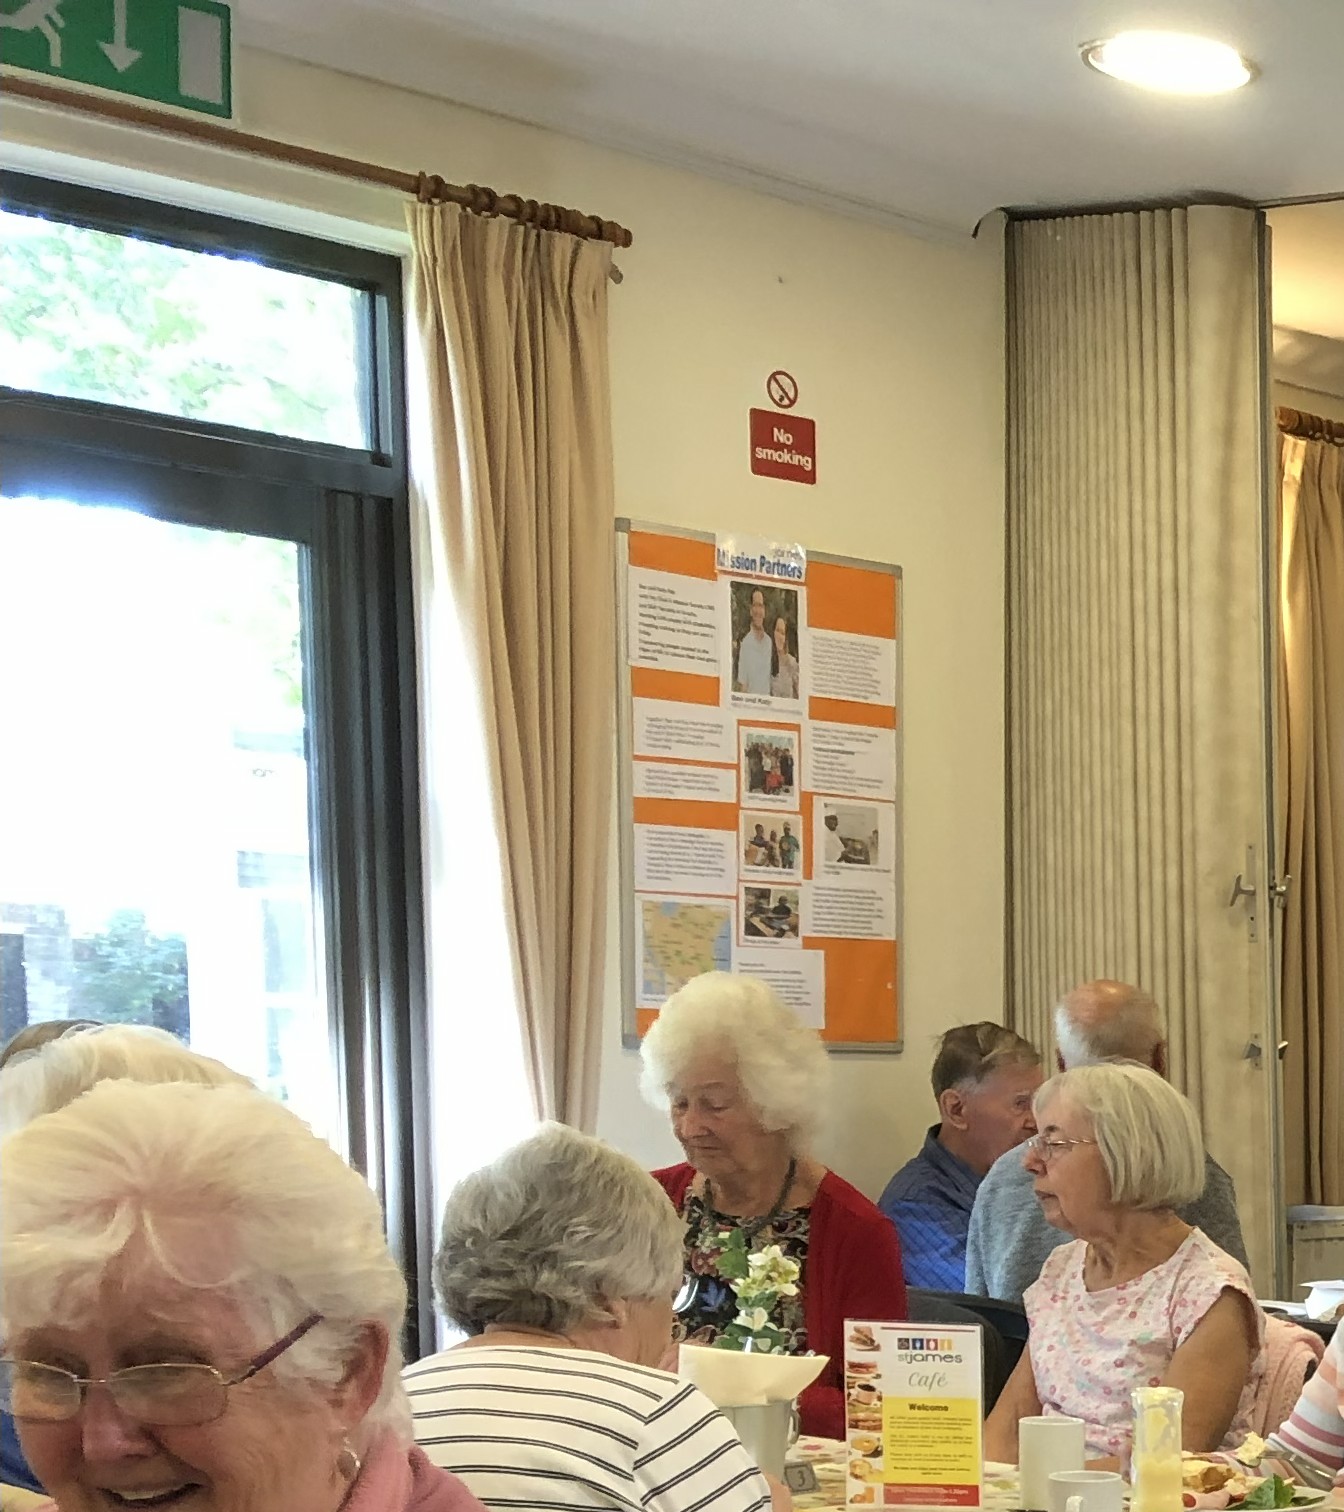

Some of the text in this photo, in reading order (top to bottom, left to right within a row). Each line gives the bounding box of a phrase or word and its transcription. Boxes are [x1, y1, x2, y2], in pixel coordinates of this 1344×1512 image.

[773, 427, 793, 445] No
[755, 447, 812, 471] smoking
[759, 555, 803, 579] Partners
[908, 1372, 949, 1391] Café
[908, 1403, 949, 1412] Welcome
[797, 1470, 806, 1487] 3
